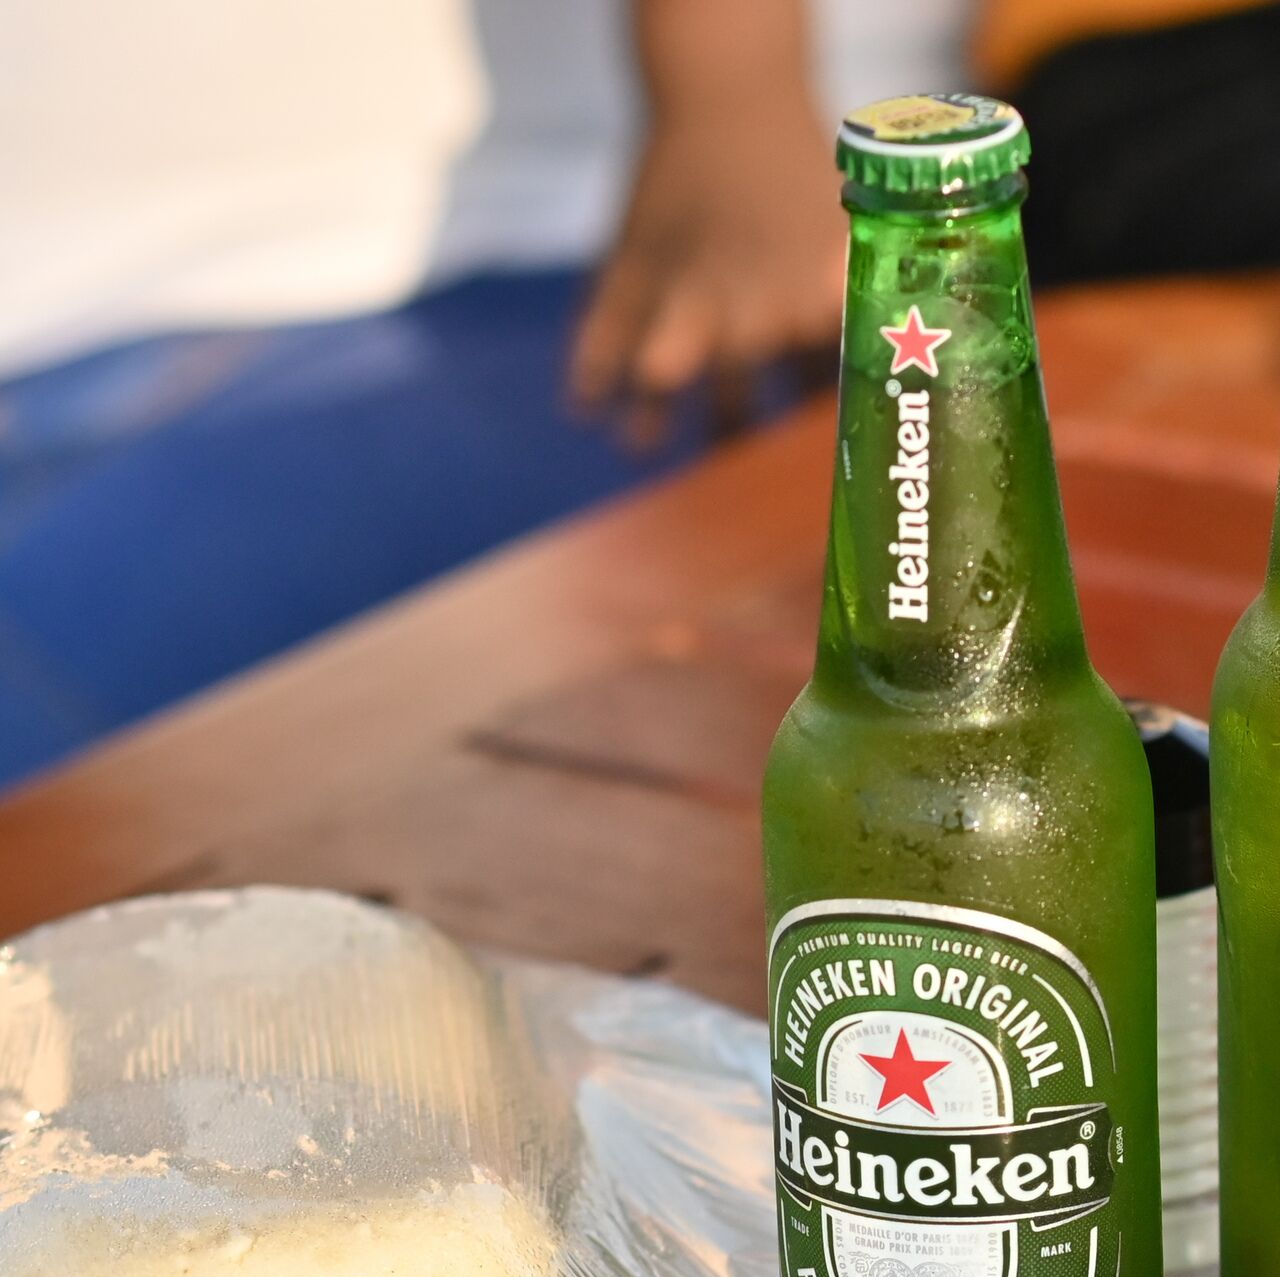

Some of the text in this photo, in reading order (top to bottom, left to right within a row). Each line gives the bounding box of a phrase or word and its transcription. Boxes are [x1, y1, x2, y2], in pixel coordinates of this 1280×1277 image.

[797, 933, 1029, 976] PREMIUM QUALITY LAGER BEER
[784, 959, 1064, 1088] HEINEKEN ORIGINAL
[828, 1054, 841, 1105] DIPLOME
[837, 1024, 891, 1053] D'HONNEUR
[913, 1026, 979, 1065] AMSTERDAM
[845, 1090, 870, 1107] EST.
[791, 1216, 810, 1237] TRADE
[836, 1218, 844, 1248] HORS
[849, 1223, 891, 1240] MEDAILLE
[895, 1231, 918, 1242] D'OR
[923, 1233, 951, 1244] PARIS
[854, 1236, 885, 1251] GRAND
[889, 1241, 912, 1254] PRIX
[915, 1245, 945, 1256] PARIS
[1041, 1242, 1072, 1258] MARK
